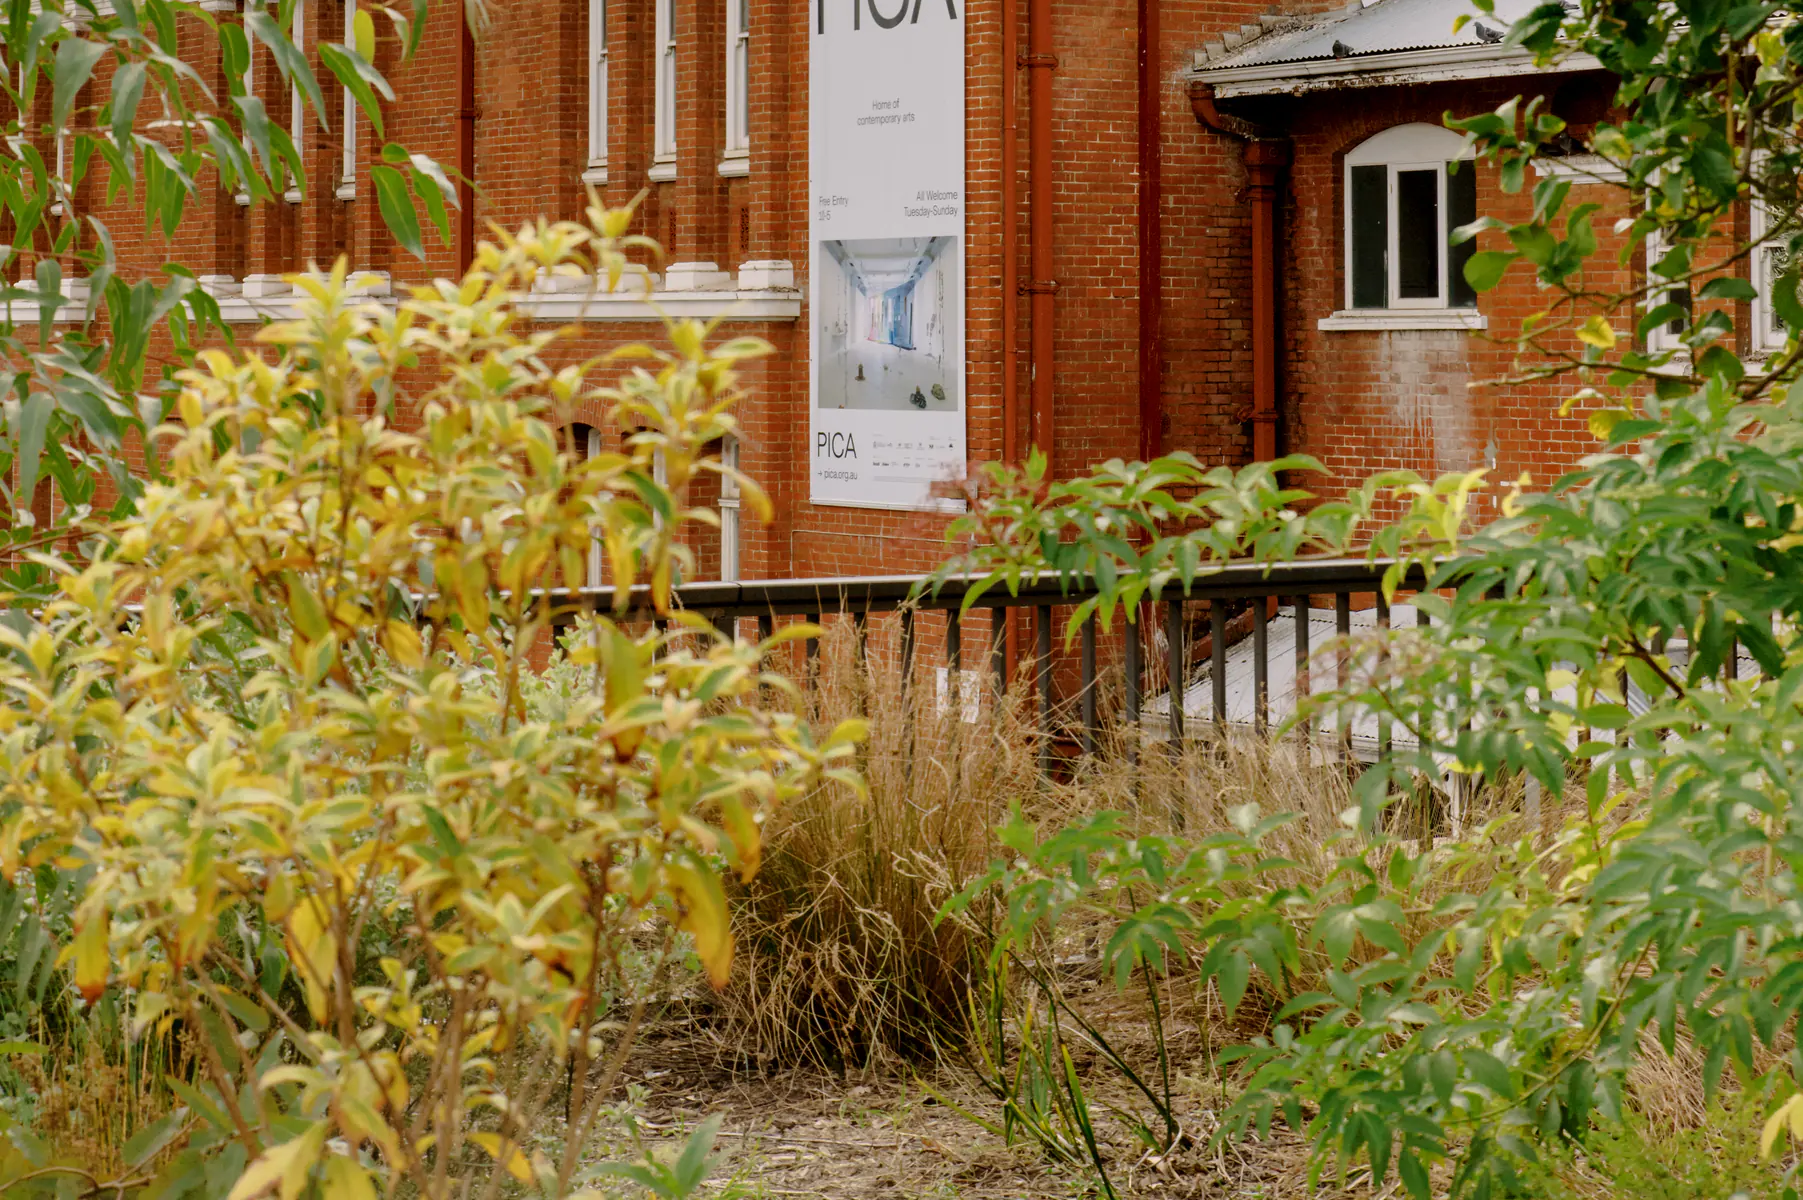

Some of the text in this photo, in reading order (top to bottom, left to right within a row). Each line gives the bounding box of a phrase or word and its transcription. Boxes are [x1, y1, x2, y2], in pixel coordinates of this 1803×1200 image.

[872, 98, 900, 111] Home of
[857, 112, 915, 127] contemporary arts
[819, 195, 849, 207] Free Entry
[916, 189, 958, 201] All Welcome
[904, 205, 958, 219] Tuesday-Sunday
[817, 432, 857, 458] PICA
[824, 468, 857, 482] pica.org.au
